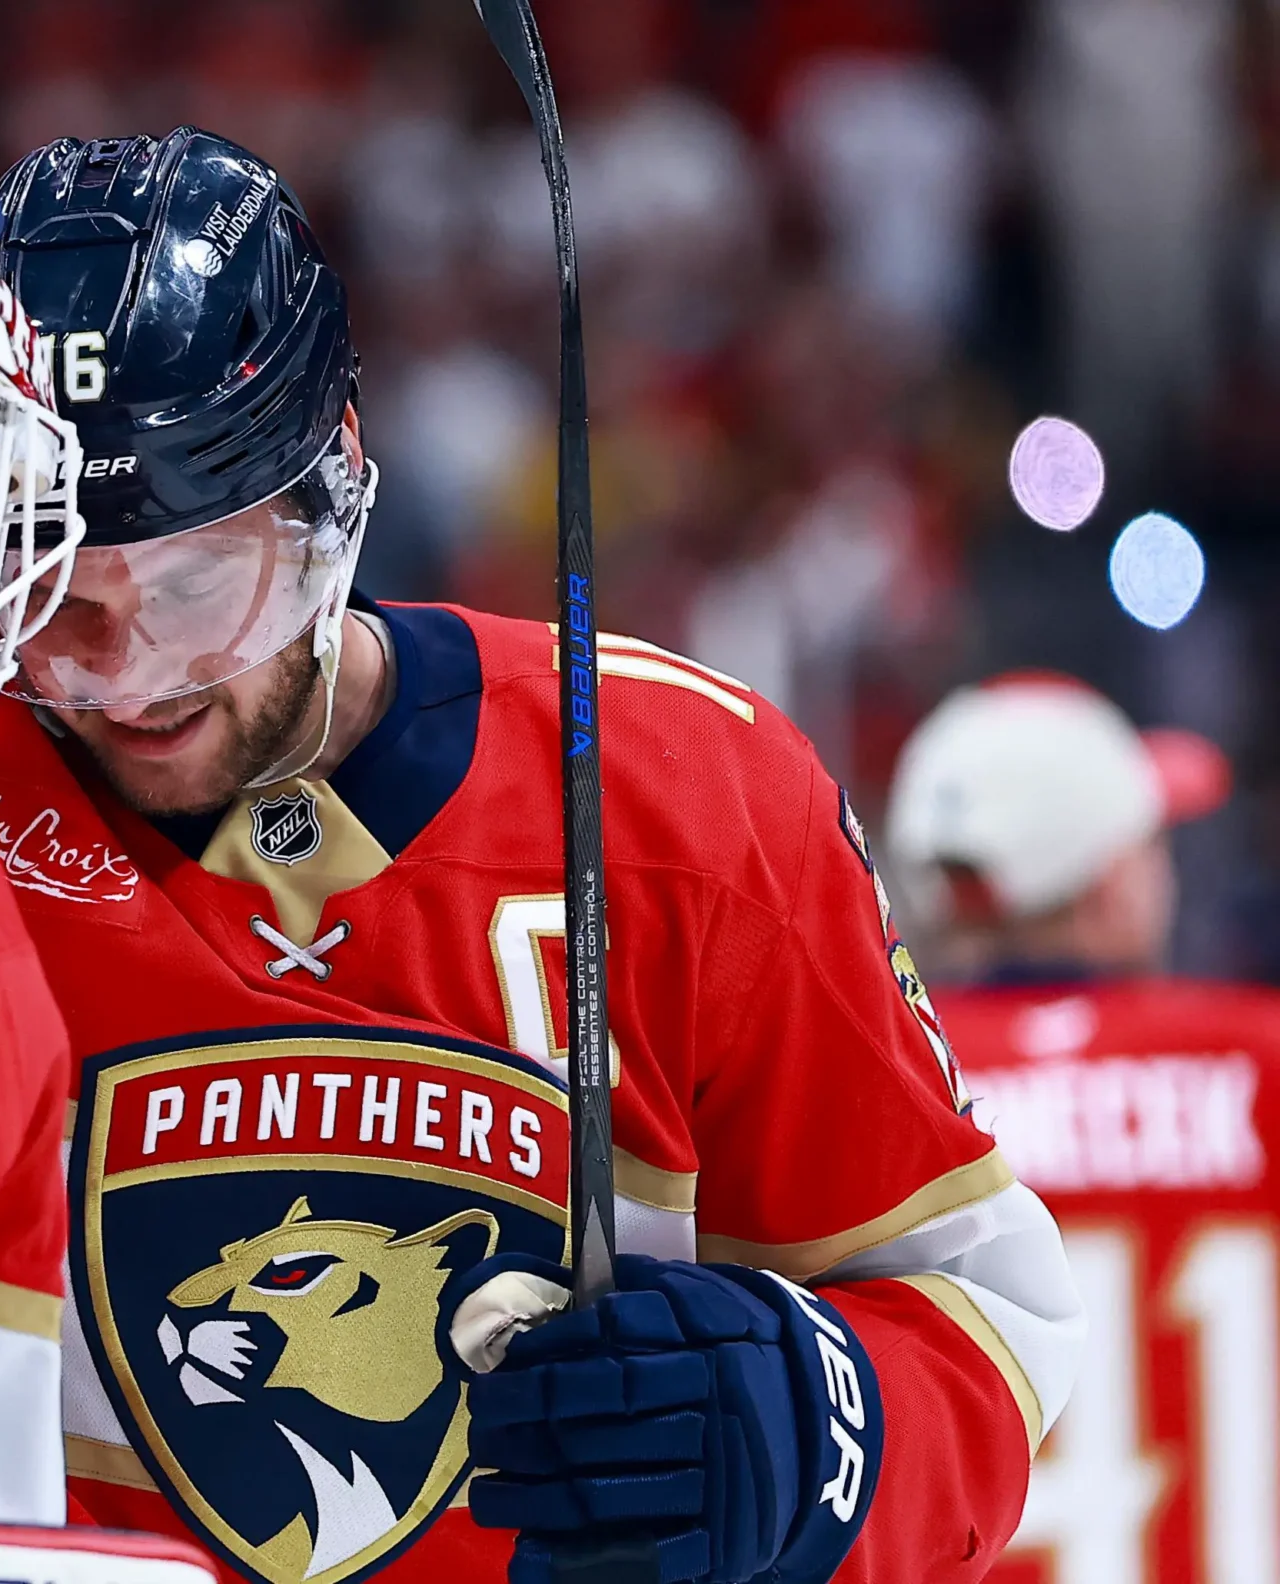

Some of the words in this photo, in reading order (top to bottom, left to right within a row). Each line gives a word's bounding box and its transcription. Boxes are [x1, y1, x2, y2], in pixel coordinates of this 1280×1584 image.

[200, 201, 231, 240] VISIT
[268, 810, 306, 851] NHL
[588, 962, 598, 985] LE
[578, 1005, 587, 1038] THE
[589, 990, 600, 1087] RESSENTEZ
[142, 1072, 541, 1179] PANTHERS
